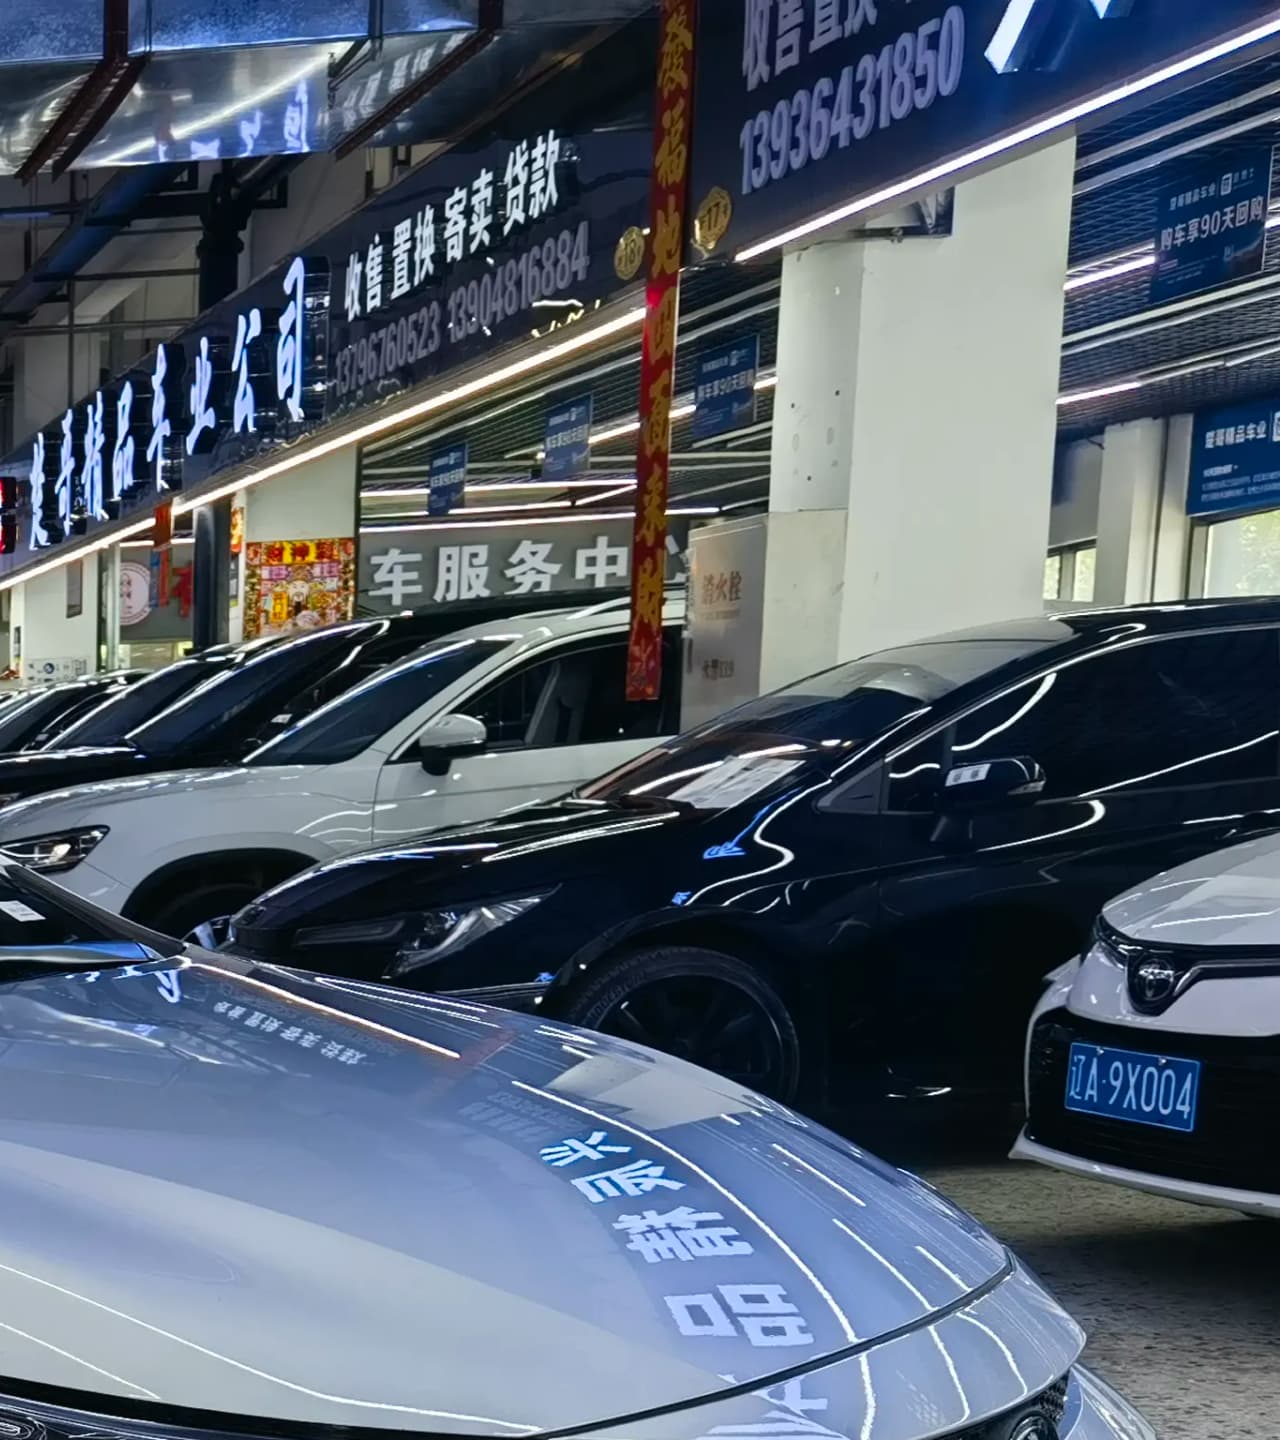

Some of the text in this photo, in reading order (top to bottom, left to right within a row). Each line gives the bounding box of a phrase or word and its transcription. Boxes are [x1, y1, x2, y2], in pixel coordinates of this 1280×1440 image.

[739, 5, 966, 195] 13936431850
[390, 204, 436, 300] 置换
[444, 168, 493, 262] 寄卖
[503, 129, 560, 237] 贷款
[448, 221, 590, 343] 13904816884
